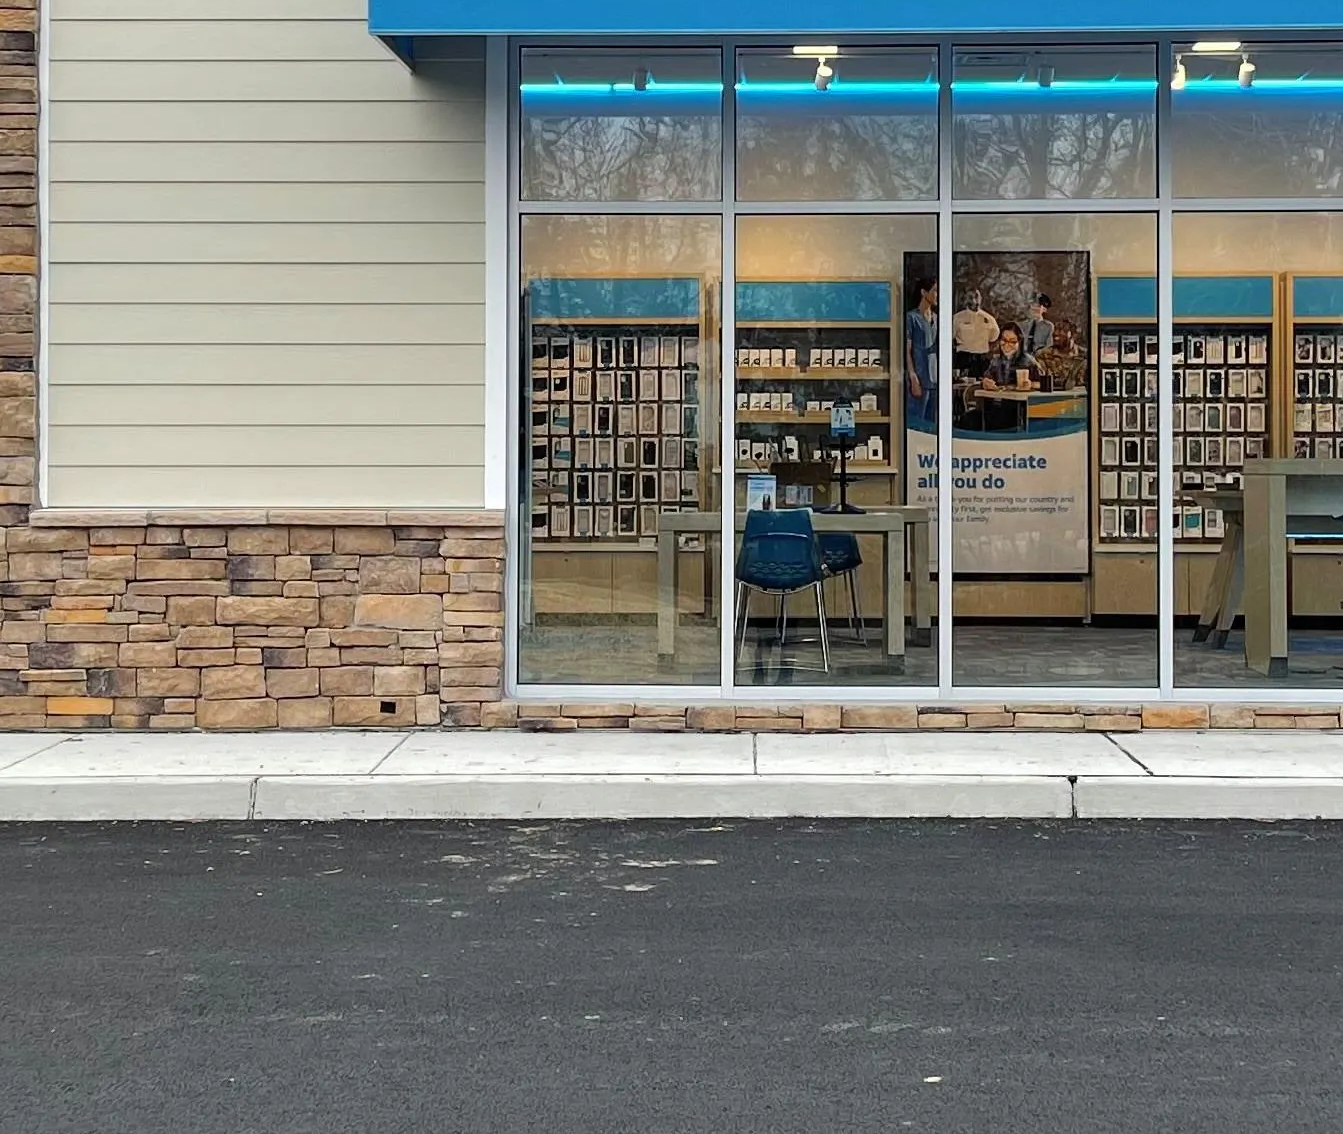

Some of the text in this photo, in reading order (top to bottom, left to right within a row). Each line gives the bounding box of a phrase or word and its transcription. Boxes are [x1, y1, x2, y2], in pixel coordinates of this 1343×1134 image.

[917, 454, 1047, 473] W appreciate
[952, 477, 976, 489] ou
[982, 474, 1005, 489] do
